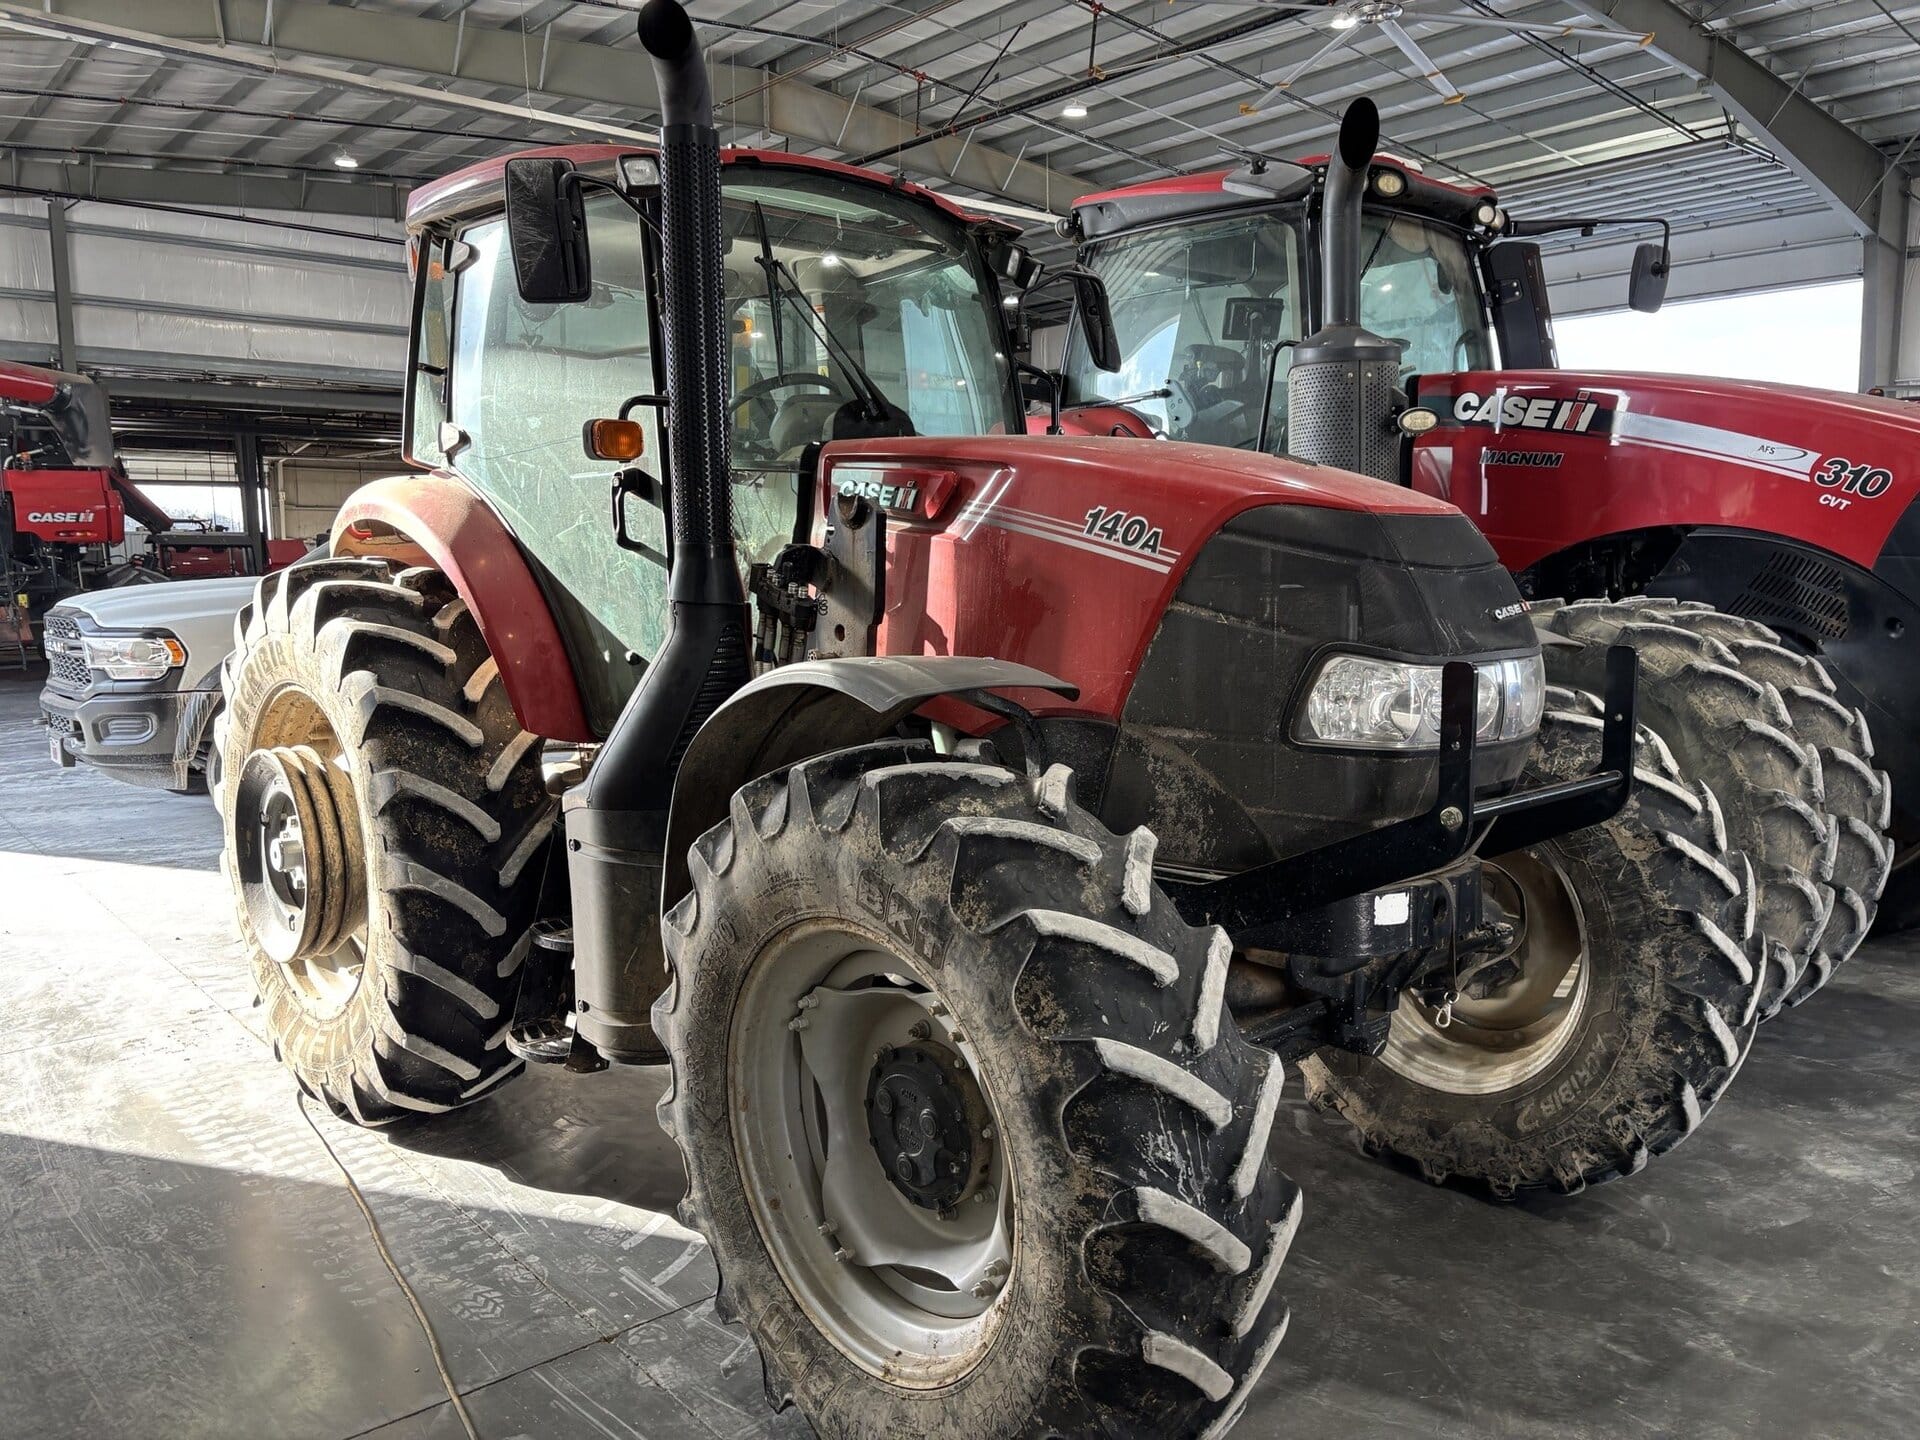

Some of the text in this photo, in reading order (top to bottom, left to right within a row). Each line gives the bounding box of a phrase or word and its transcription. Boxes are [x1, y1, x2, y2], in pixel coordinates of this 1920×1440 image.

[1452, 391, 1556, 430] CASE
[1480, 449, 1564, 469] MAGNUM
[1757, 443, 1776, 457] AFS
[1814, 457, 1893, 500] 310
[1818, 493, 1853, 512] CVT
[28, 511, 77, 523] CASE
[1083, 505, 1163, 555] 140A
[1494, 604, 1522, 620] CASE
